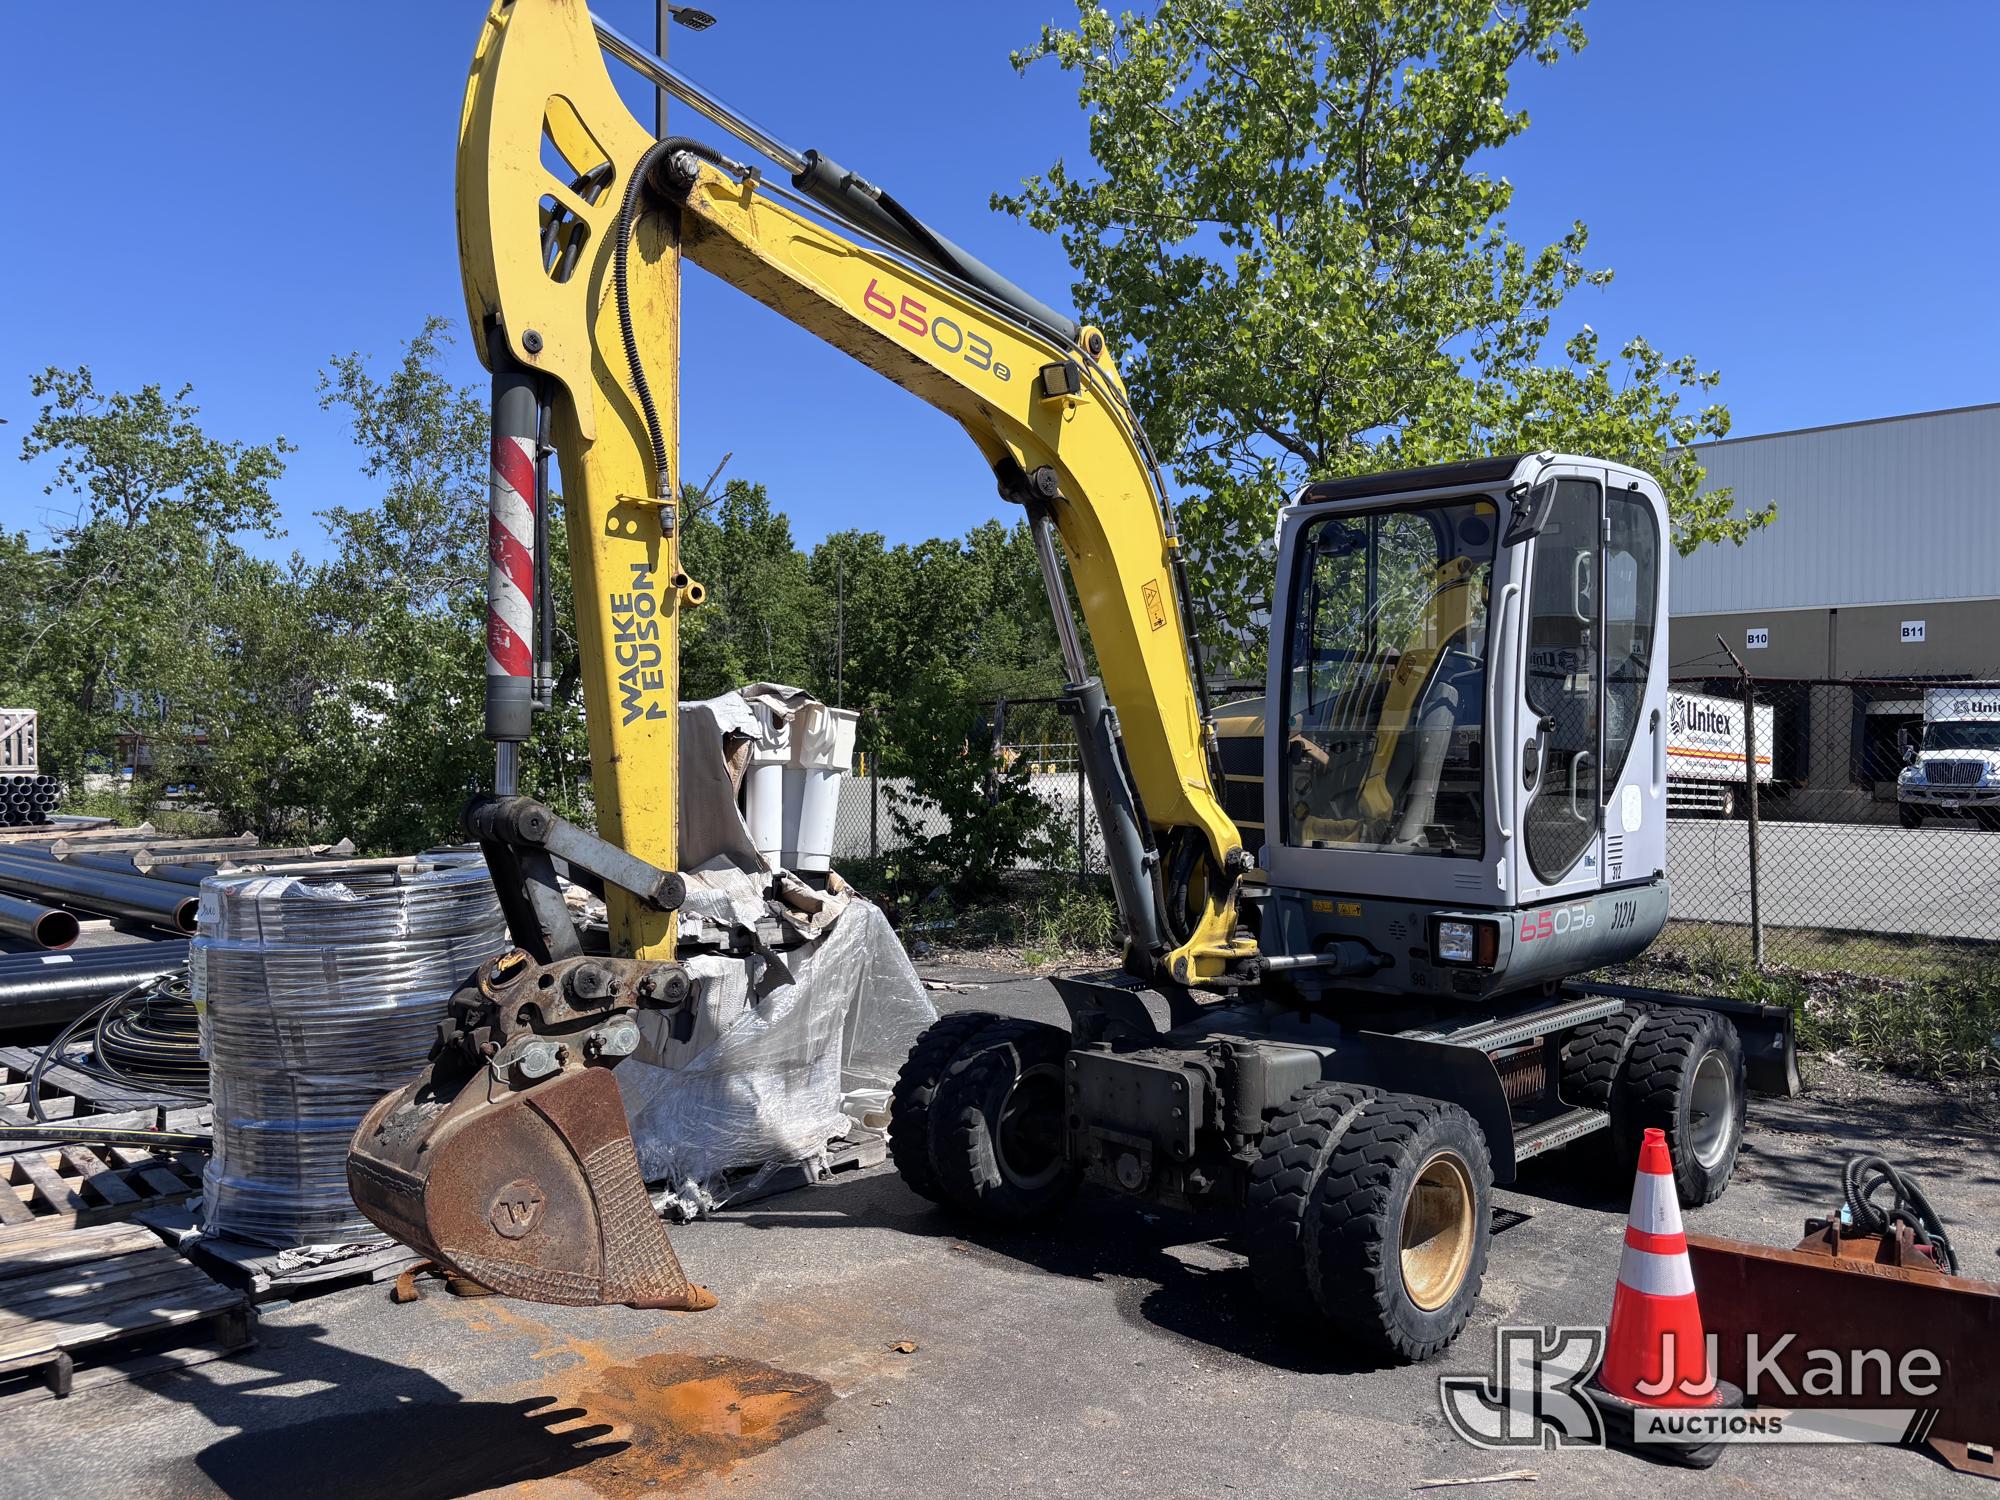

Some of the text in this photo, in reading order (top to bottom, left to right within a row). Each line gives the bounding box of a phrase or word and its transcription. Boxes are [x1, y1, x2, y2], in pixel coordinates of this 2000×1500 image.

[864, 279, 993, 371] 6503
[1747, 634, 1767, 644] B10
[1902, 626, 1924, 637] B11
[1687, 701, 1731, 735] Unitex
[1520, 904, 1586, 942] 6503
[1611, 900, 1637, 930] 31214
